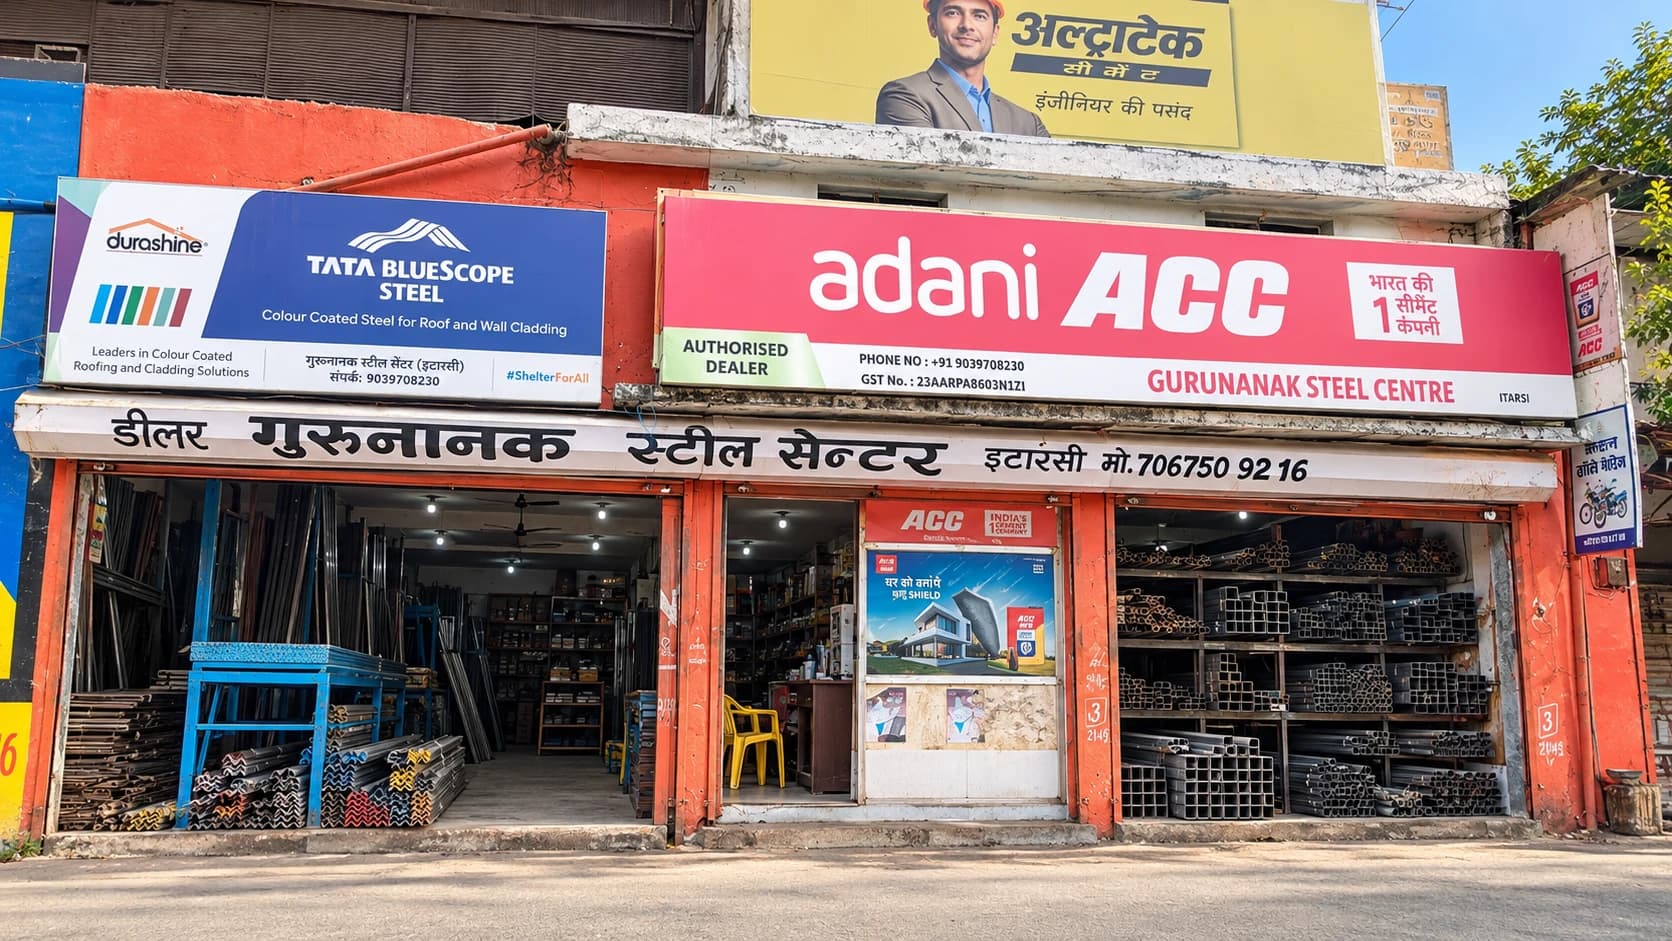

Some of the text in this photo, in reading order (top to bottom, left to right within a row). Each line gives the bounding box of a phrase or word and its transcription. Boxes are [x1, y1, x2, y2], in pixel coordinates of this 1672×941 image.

[1011, 12, 1206, 60] अल्ट्राटेक
[1035, 89, 1193, 121] इंजीनियर की पसंद
[106, 232, 203, 253] durashine
[307, 255, 376, 278] TATA
[809, 236, 1039, 321] adani
[1368, 272, 1434, 293] भारत की
[379, 282, 445, 304] STEEL
[1060, 251, 1290, 337] ACC
[1373, 296, 1390, 333] 1
[1395, 293, 1438, 315] सीमेंट
[262, 309, 568, 337] Colour Coated Steel for Roof and Wall Cladding
[1396, 315, 1440, 336] कंपनी
[92, 346, 233, 362] Leaders in Colour Coated
[683, 339, 789, 357] AUTHORISED
[73, 361, 250, 379] Roofing and Cladding Solutions
[360, 354, 388, 369] स्टील
[390, 355, 414, 370] सेंटर
[417, 358, 465, 374] (इटारसी)
[706, 360, 768, 376] DEALER
[859, 353, 901, 366] PHONE
[903, 355, 922, 367] NO
[931, 357, 953, 368] +91
[955, 357, 1025, 372] 9039708230
[329, 369, 440, 386] संपर्क: 9039708230
[506, 370, 590, 384] #ShelterForAll
[861, 373, 884, 386] GST
[887, 375, 908, 387] No.
[1147, 369, 1456, 403] GURUNANAK STEEL CENTRE
[1499, 392, 1531, 404] ITARSI
[111, 407, 209, 451] डीलर
[626, 425, 761, 467] स्टील
[777, 428, 949, 476] सेन्टर
[900, 509, 965, 532] ACC
[991, 513, 1027, 522] INDIA'S
[908, 590, 941, 600] SHIELD
[1542, 711, 1553, 732] 3
[0, 732, 18, 777] 6
